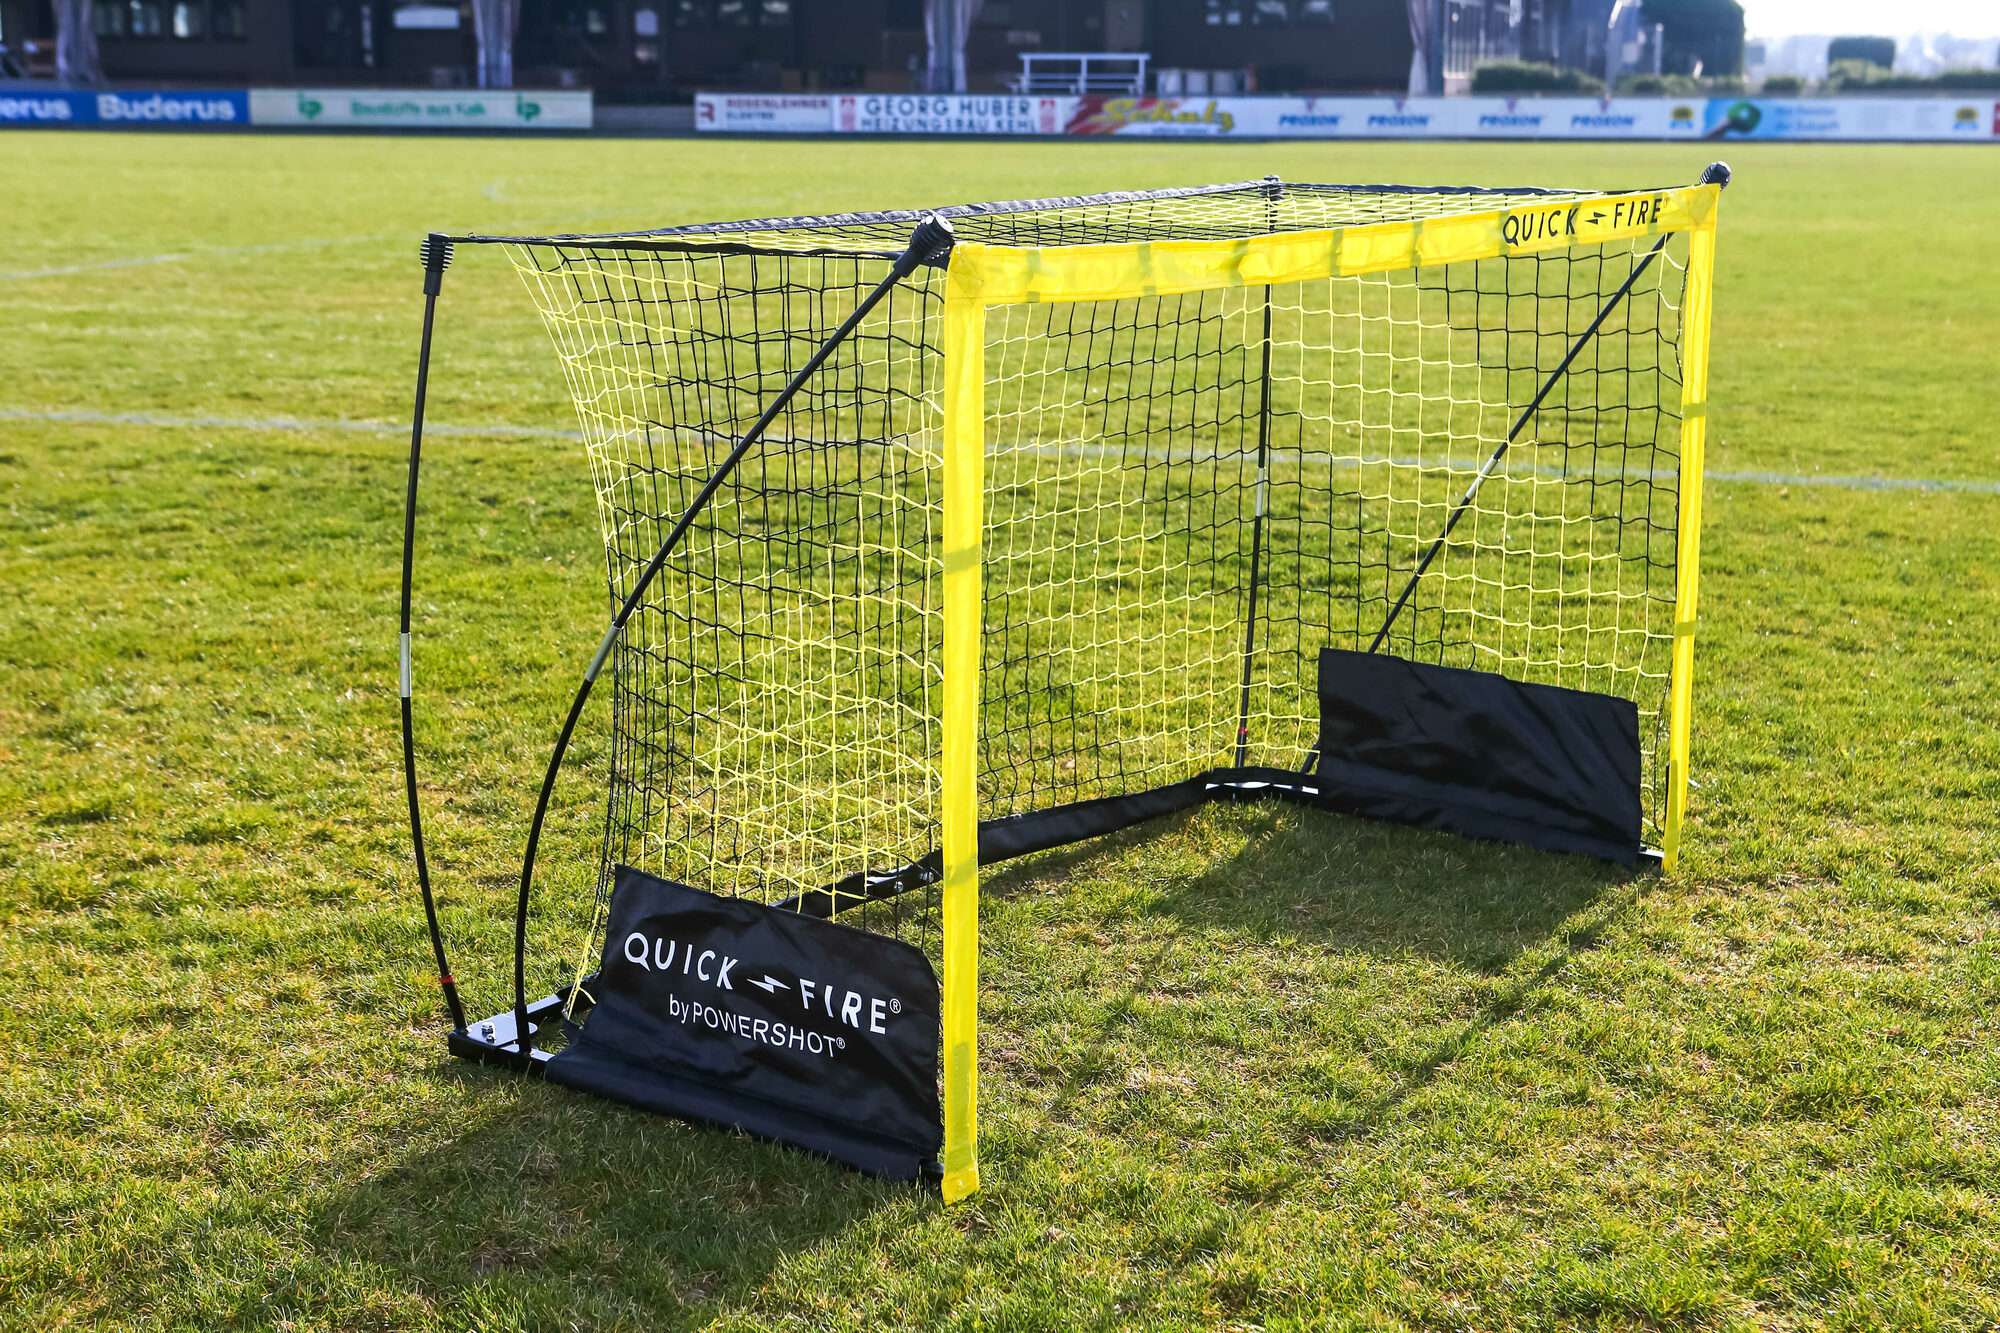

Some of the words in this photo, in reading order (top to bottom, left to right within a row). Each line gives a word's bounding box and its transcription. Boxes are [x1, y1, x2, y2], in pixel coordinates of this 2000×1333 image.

[97, 93, 236, 120] Buderus
[865, 98, 949, 116] GEORG
[960, 99, 1031, 117] HUBER
[861, 117, 988, 132] HEIZUNGSBAU
[1503, 207, 1579, 246] QUICK
[624, 932, 738, 991] QUICK
